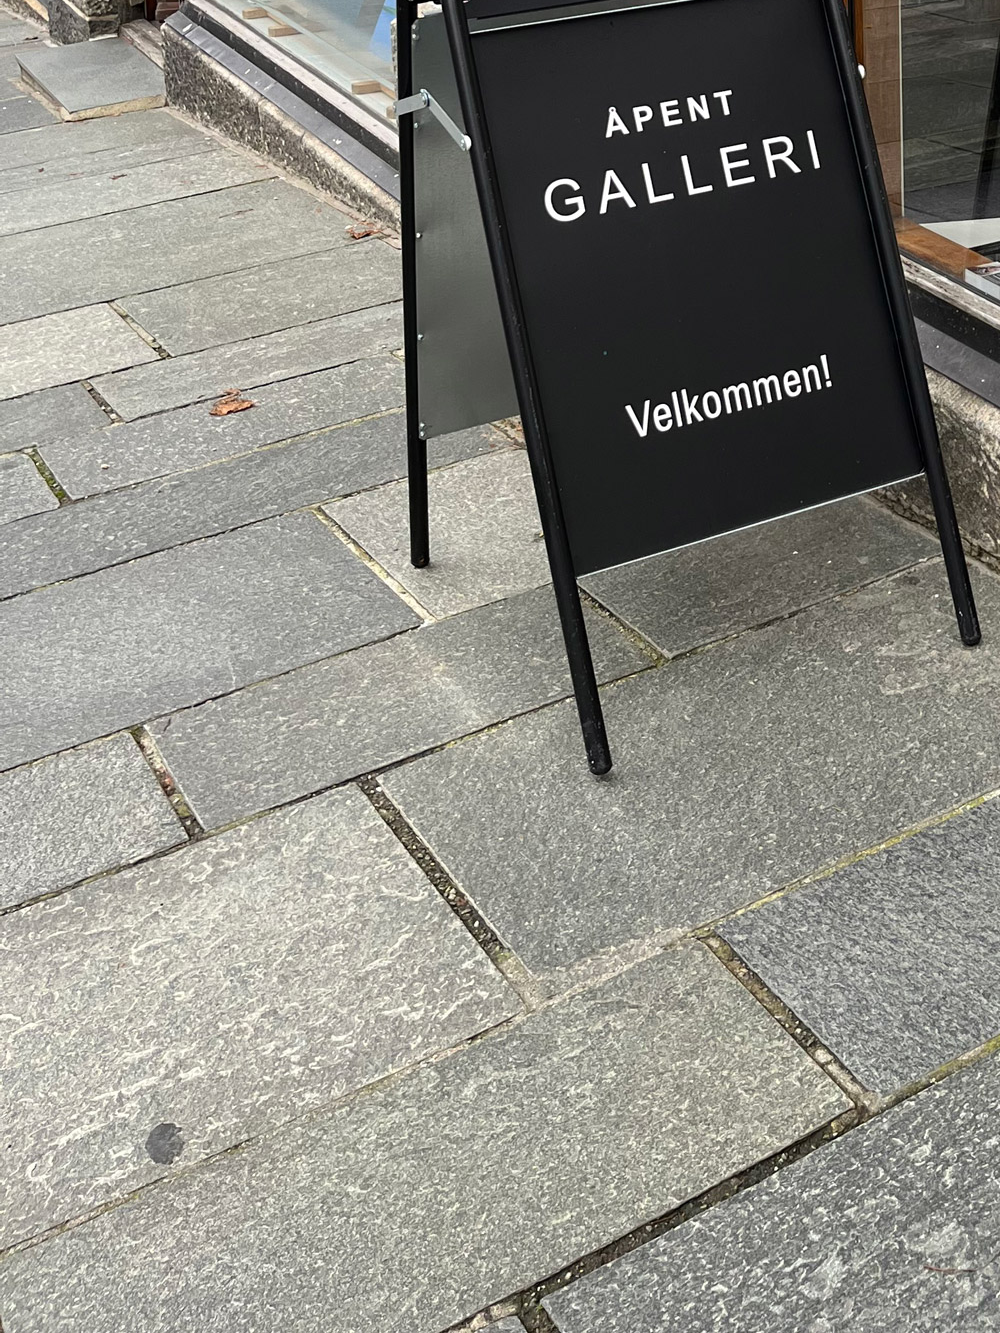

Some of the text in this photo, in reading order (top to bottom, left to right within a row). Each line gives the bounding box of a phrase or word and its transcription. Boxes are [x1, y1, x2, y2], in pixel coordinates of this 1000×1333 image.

[605, 90, 733, 138] ÅPENT
[544, 130, 821, 223] GALLERI
[625, 354, 833, 438] Velkommen!
